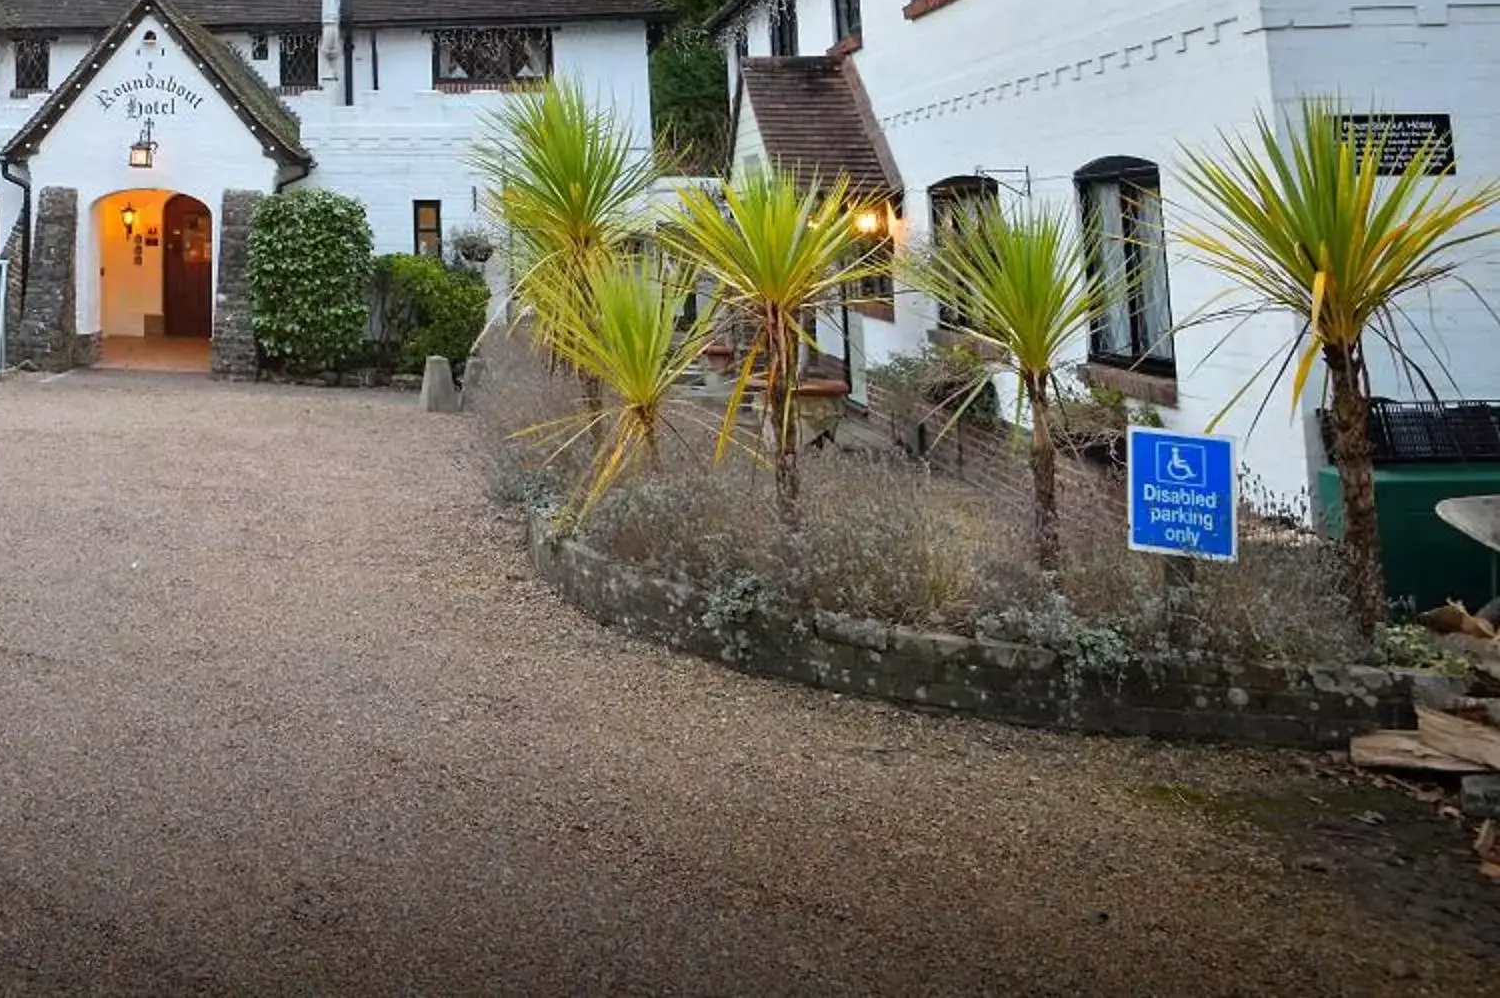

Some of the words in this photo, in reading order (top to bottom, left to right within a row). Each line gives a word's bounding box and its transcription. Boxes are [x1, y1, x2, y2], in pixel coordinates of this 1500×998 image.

[94, 73, 203, 111] Roundabout
[126, 97, 175, 119] Hotel
[1143, 483, 1217, 509] Disabled
[1150, 506, 1213, 531] parking
[1165, 526, 1201, 547] only
